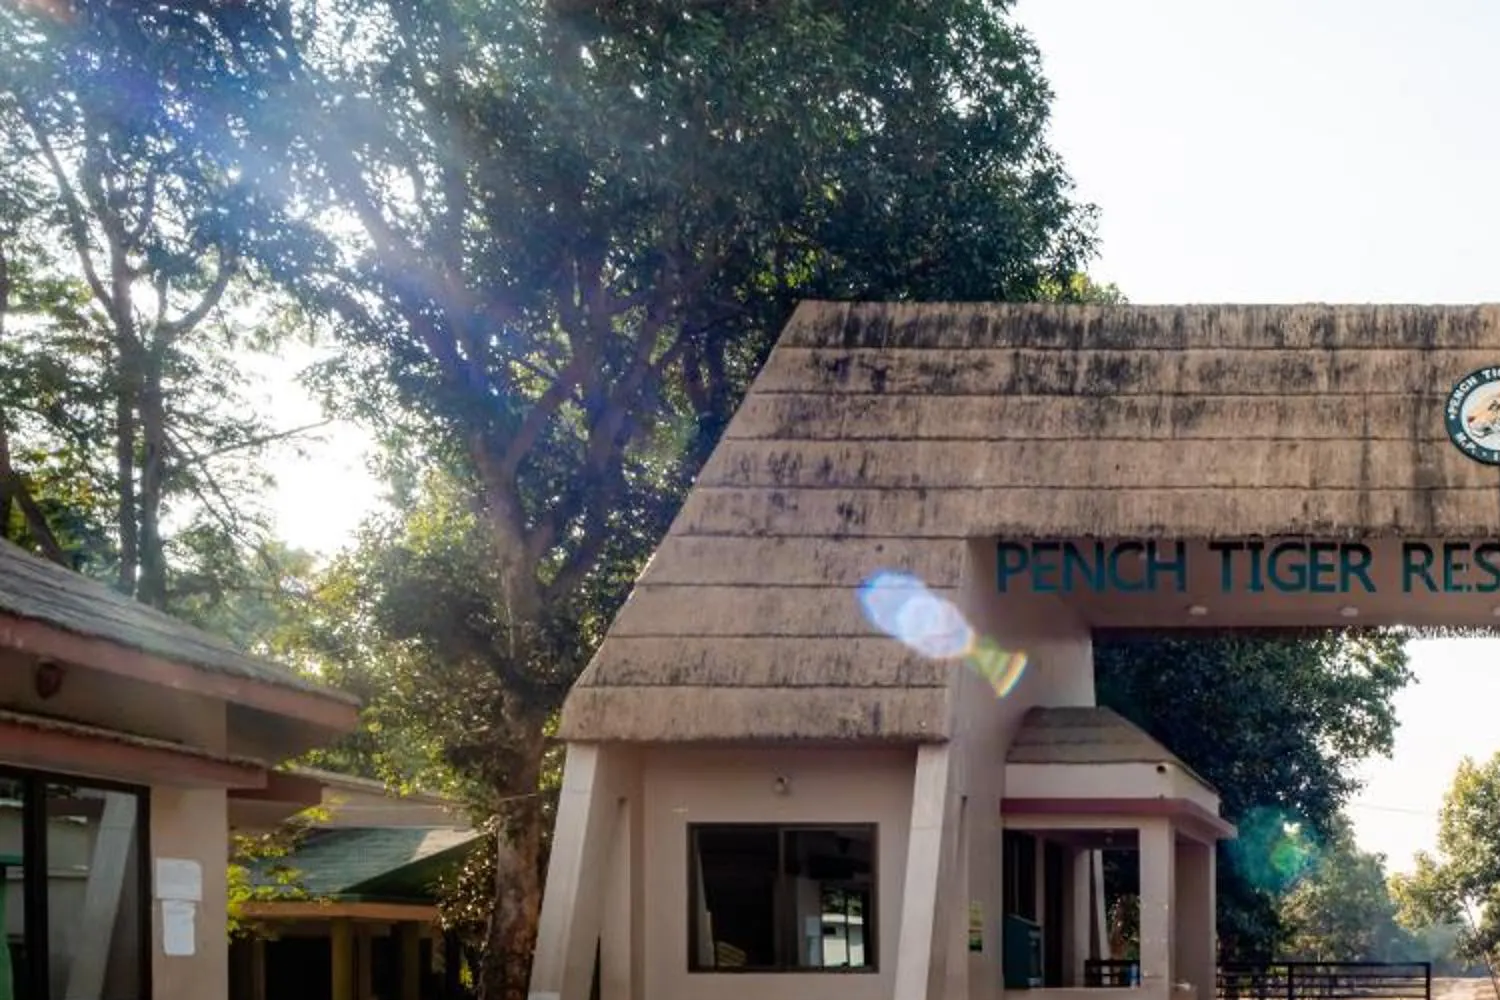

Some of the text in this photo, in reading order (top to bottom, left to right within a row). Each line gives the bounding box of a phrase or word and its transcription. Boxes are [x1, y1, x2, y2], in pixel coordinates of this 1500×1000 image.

[1447, 376, 1478, 416] PENCH
[996, 541, 1187, 593] PENCH
[1208, 541, 1378, 593] TIGER
